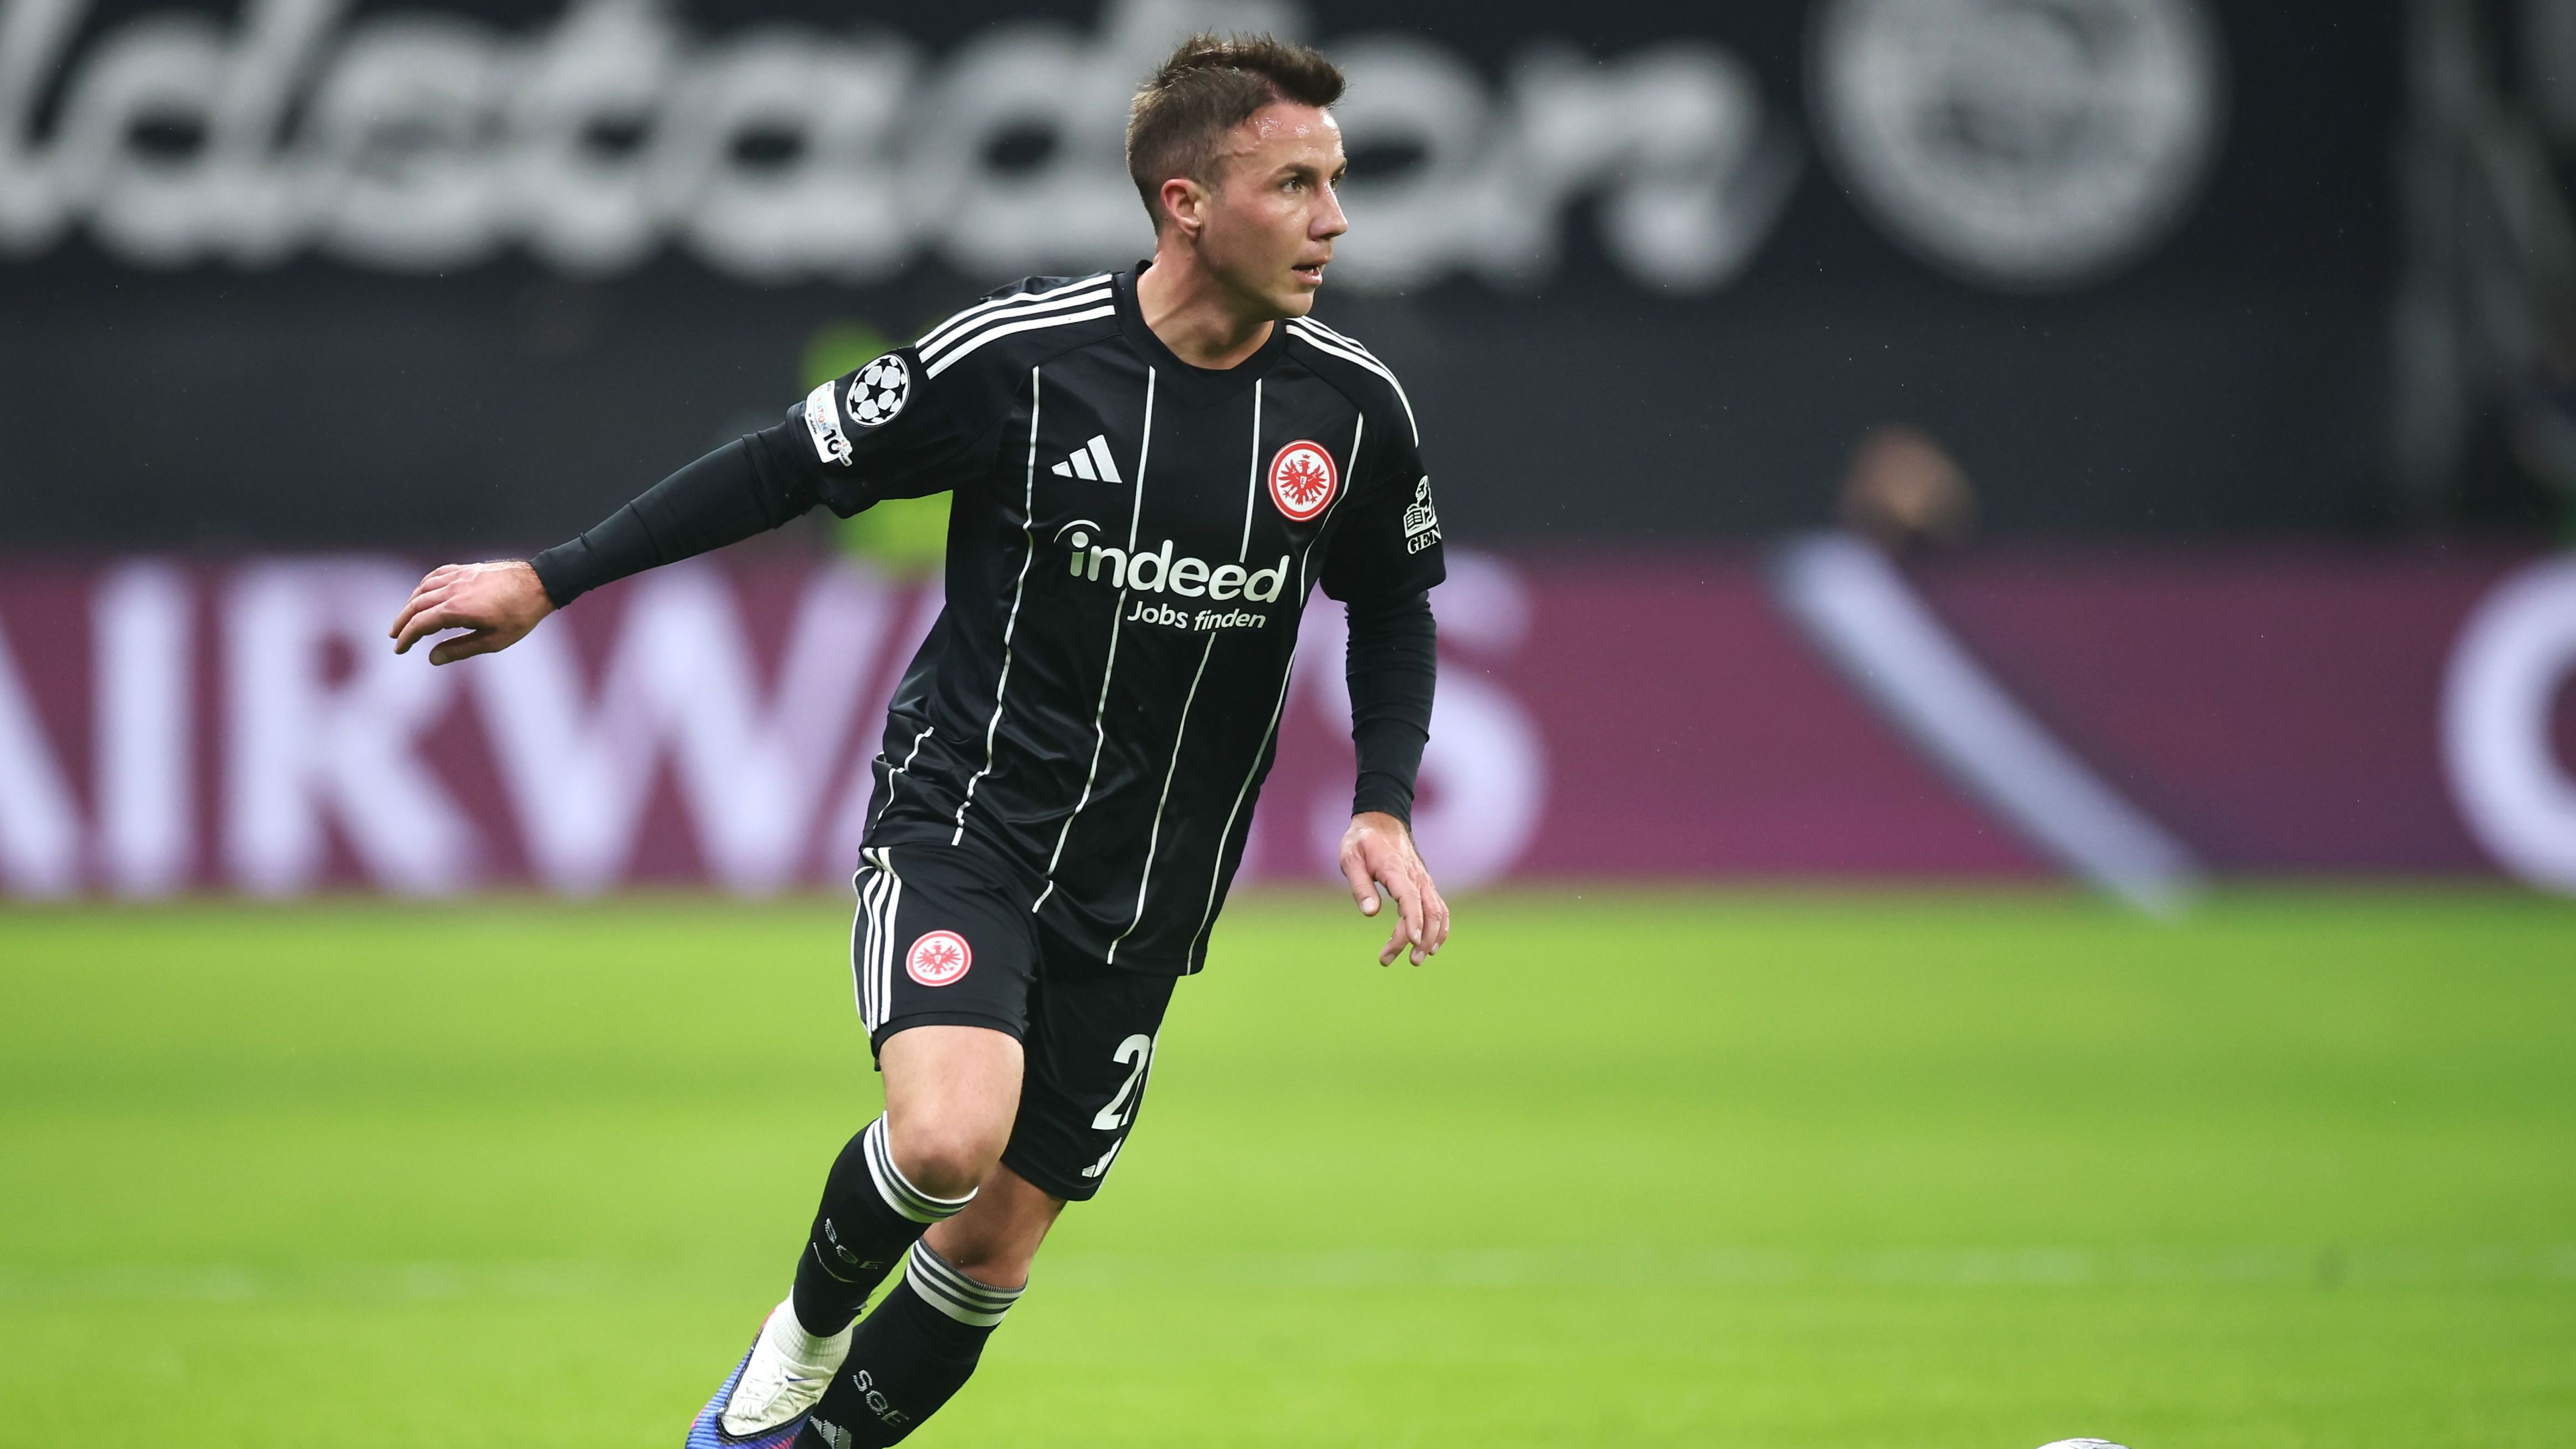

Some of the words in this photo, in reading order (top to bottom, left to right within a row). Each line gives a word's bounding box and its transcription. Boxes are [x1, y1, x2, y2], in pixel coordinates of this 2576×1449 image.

[1408, 523, 1442, 554] GEN
[1069, 530, 1290, 604] indeed
[1127, 601, 1189, 629] Jobs
[1193, 609, 1266, 631] finden
[853, 1370, 909, 1426] SGE
